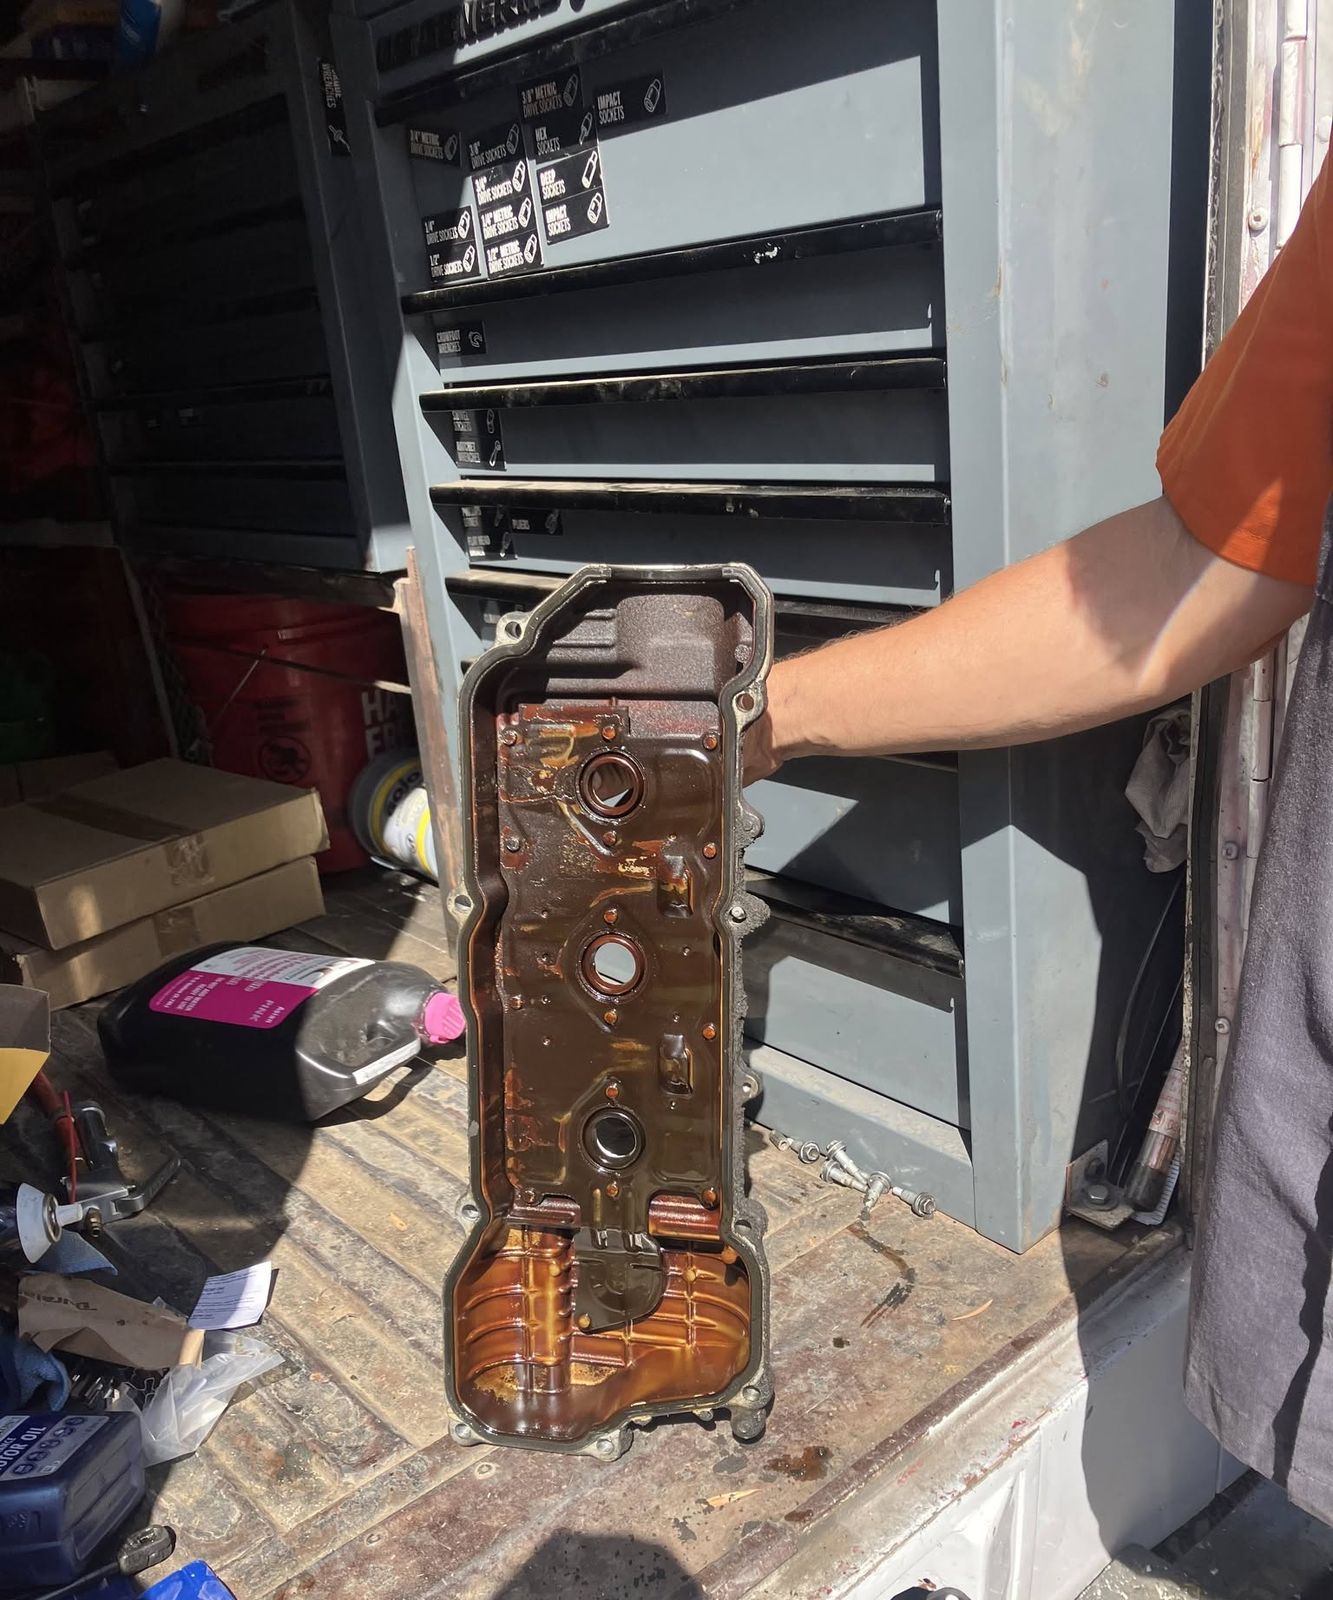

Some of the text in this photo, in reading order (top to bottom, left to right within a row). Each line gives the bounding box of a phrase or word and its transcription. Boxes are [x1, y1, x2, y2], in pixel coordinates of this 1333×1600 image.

[535, 81, 557, 99] METRIC
[523, 94, 563, 118] DRIVE SOCKETS
[597, 91, 621, 109] IMPACT
[599, 105, 624, 125] SOCKETS
[421, 131, 440, 146] METRIC
[535, 126, 548, 142] HEX
[410, 142, 444, 160] DRIVE SOCKETS
[536, 137, 560, 156] SOCKETS
[471, 144, 507, 170] DRIVE SOCKETS
[540, 168, 556, 187] DEEP
[477, 180, 513, 206] DRIVE SOCKETS
[542, 179, 566, 200] SOCKETS
[493, 204, 514, 221] METRIC
[545, 204, 567, 224] IMPACT
[426, 226, 459, 246] DRIVE SOCKETS
[483, 216, 519, 240] DRIVE SOCKETS
[547, 217, 571, 236] SOCKETS
[500, 240, 521, 258] METRIC
[431, 260, 464, 278] DRIVE SOCKETS
[488, 251, 524, 275] DRIVE SOCKETS
[249, 999, 274, 1022] PINK
[20, 1426, 47, 1441] OIL
